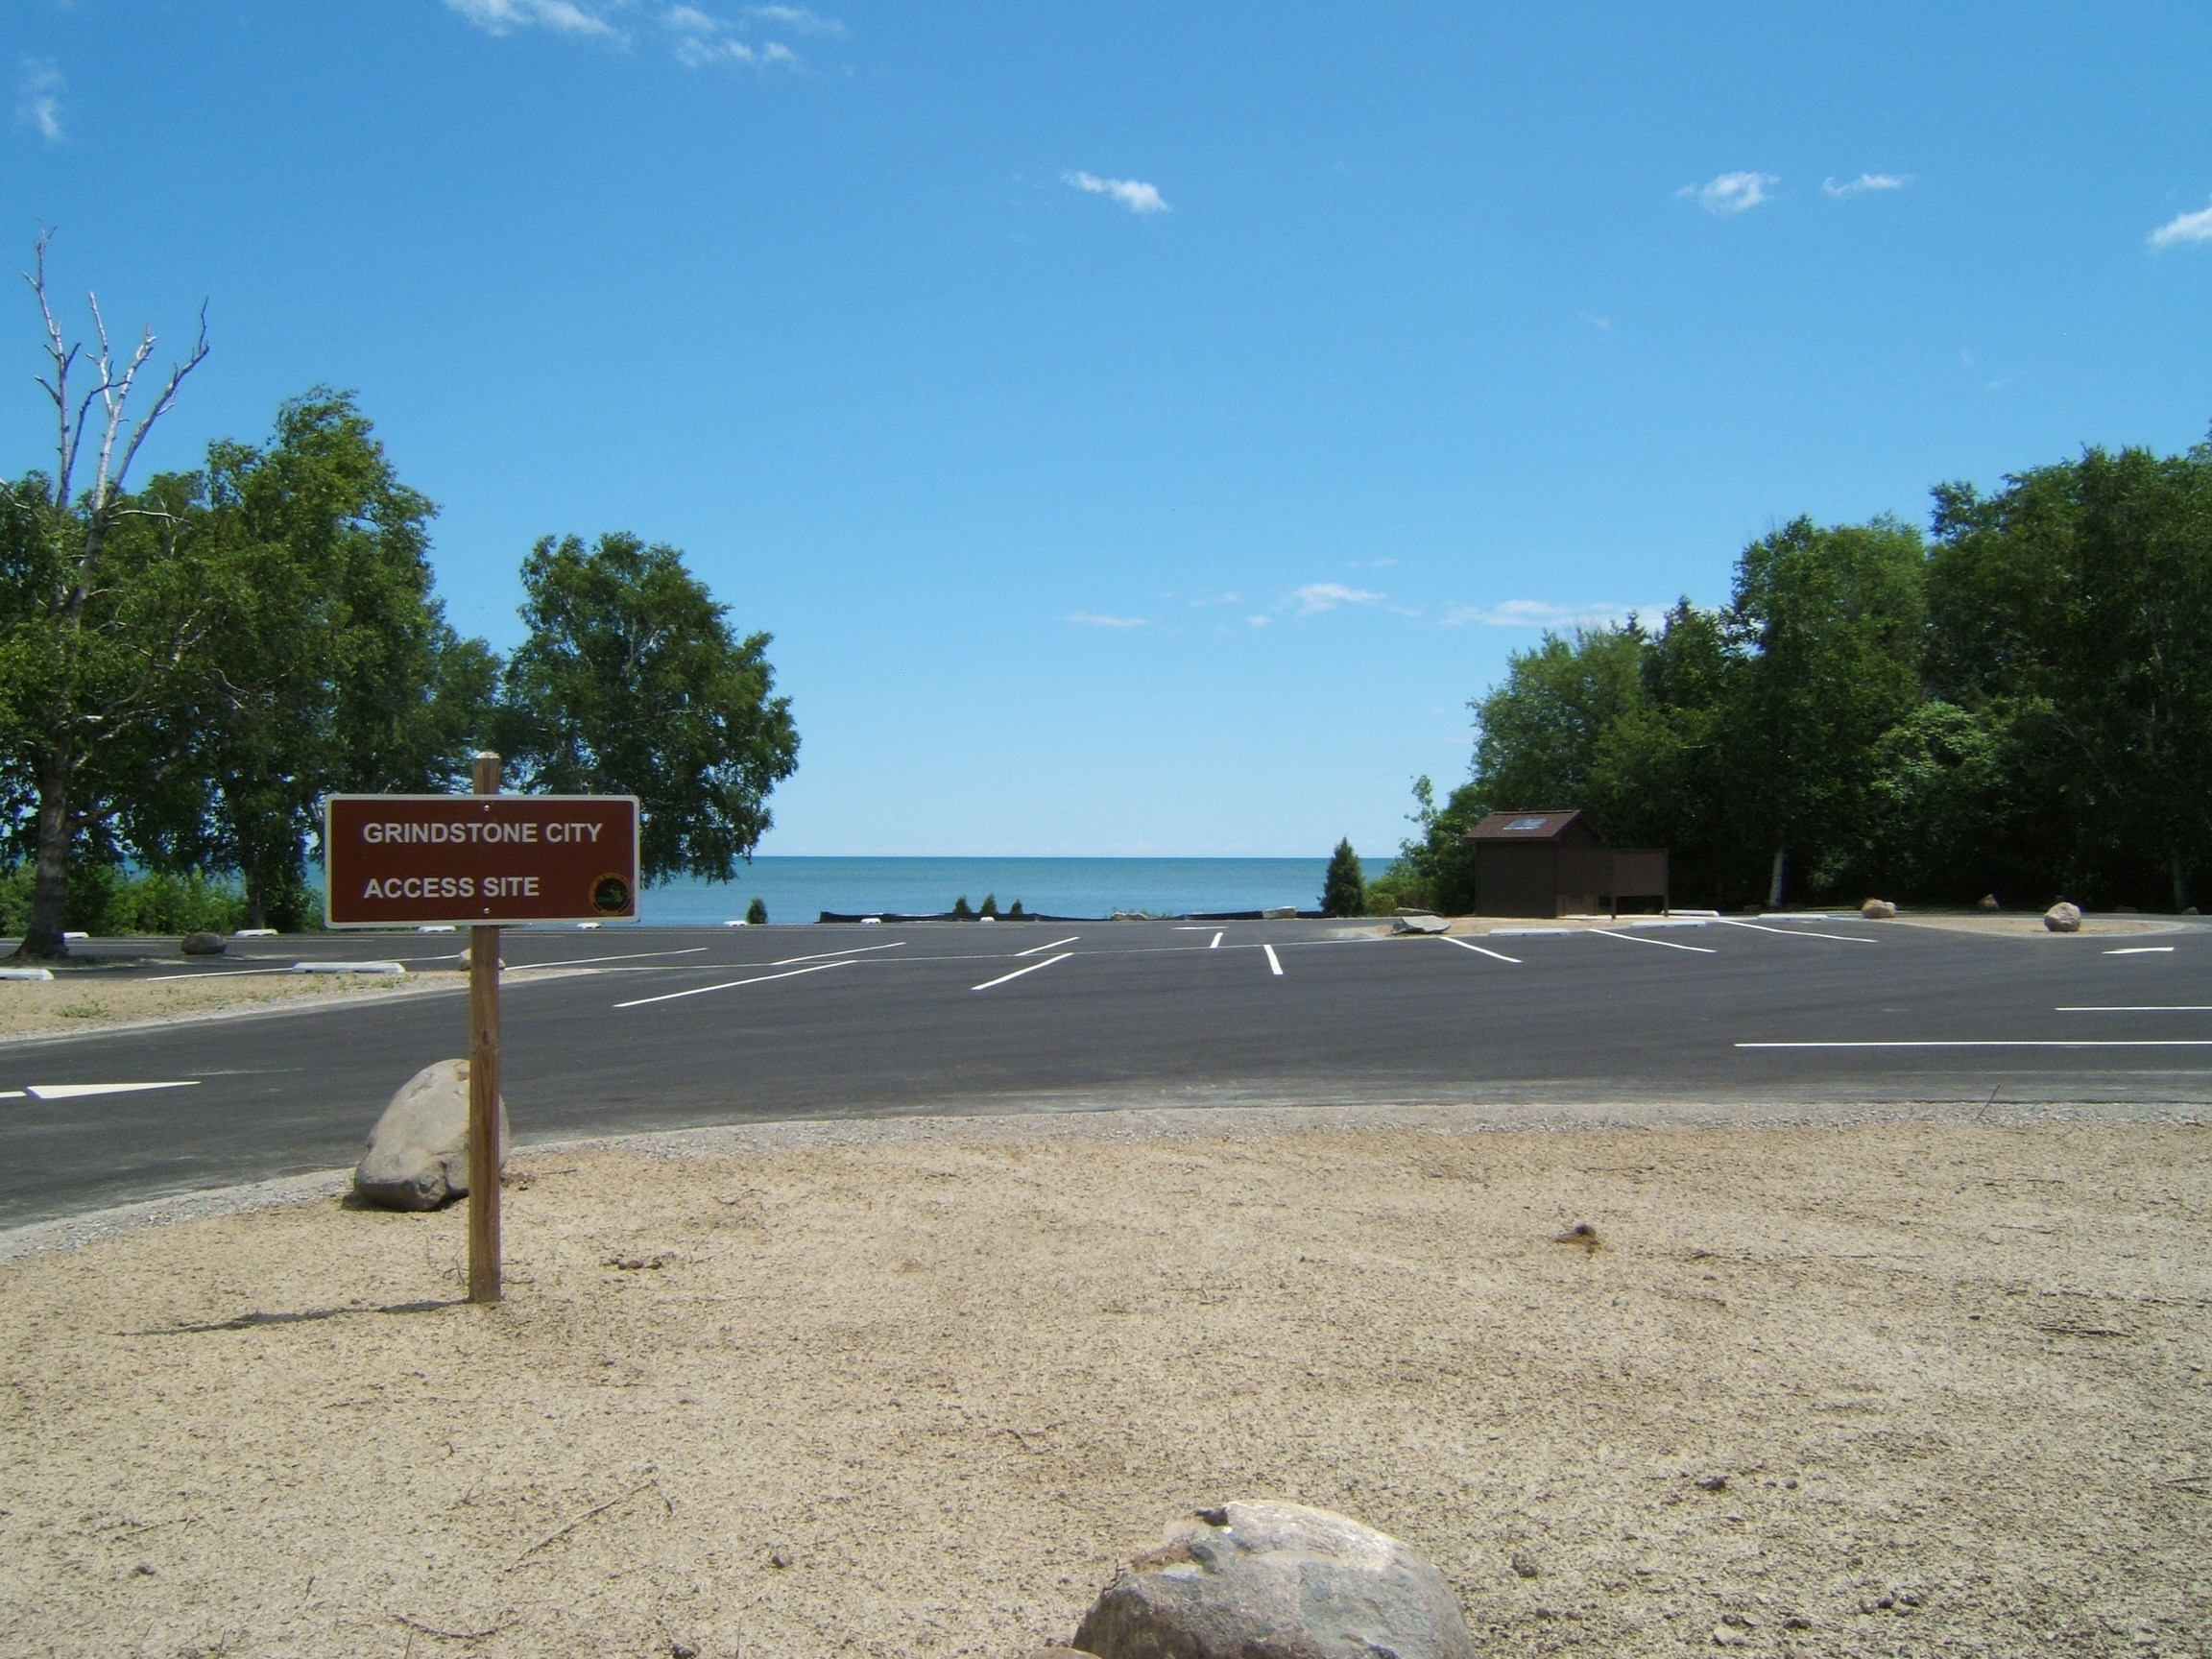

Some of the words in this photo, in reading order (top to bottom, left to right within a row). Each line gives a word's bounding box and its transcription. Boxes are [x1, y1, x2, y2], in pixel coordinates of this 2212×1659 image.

[363, 822, 538, 843] GRINDSTONE
[545, 822, 603, 843] CITY
[363, 878, 474, 899] ACCESS
[483, 877, 540, 897] SITE
